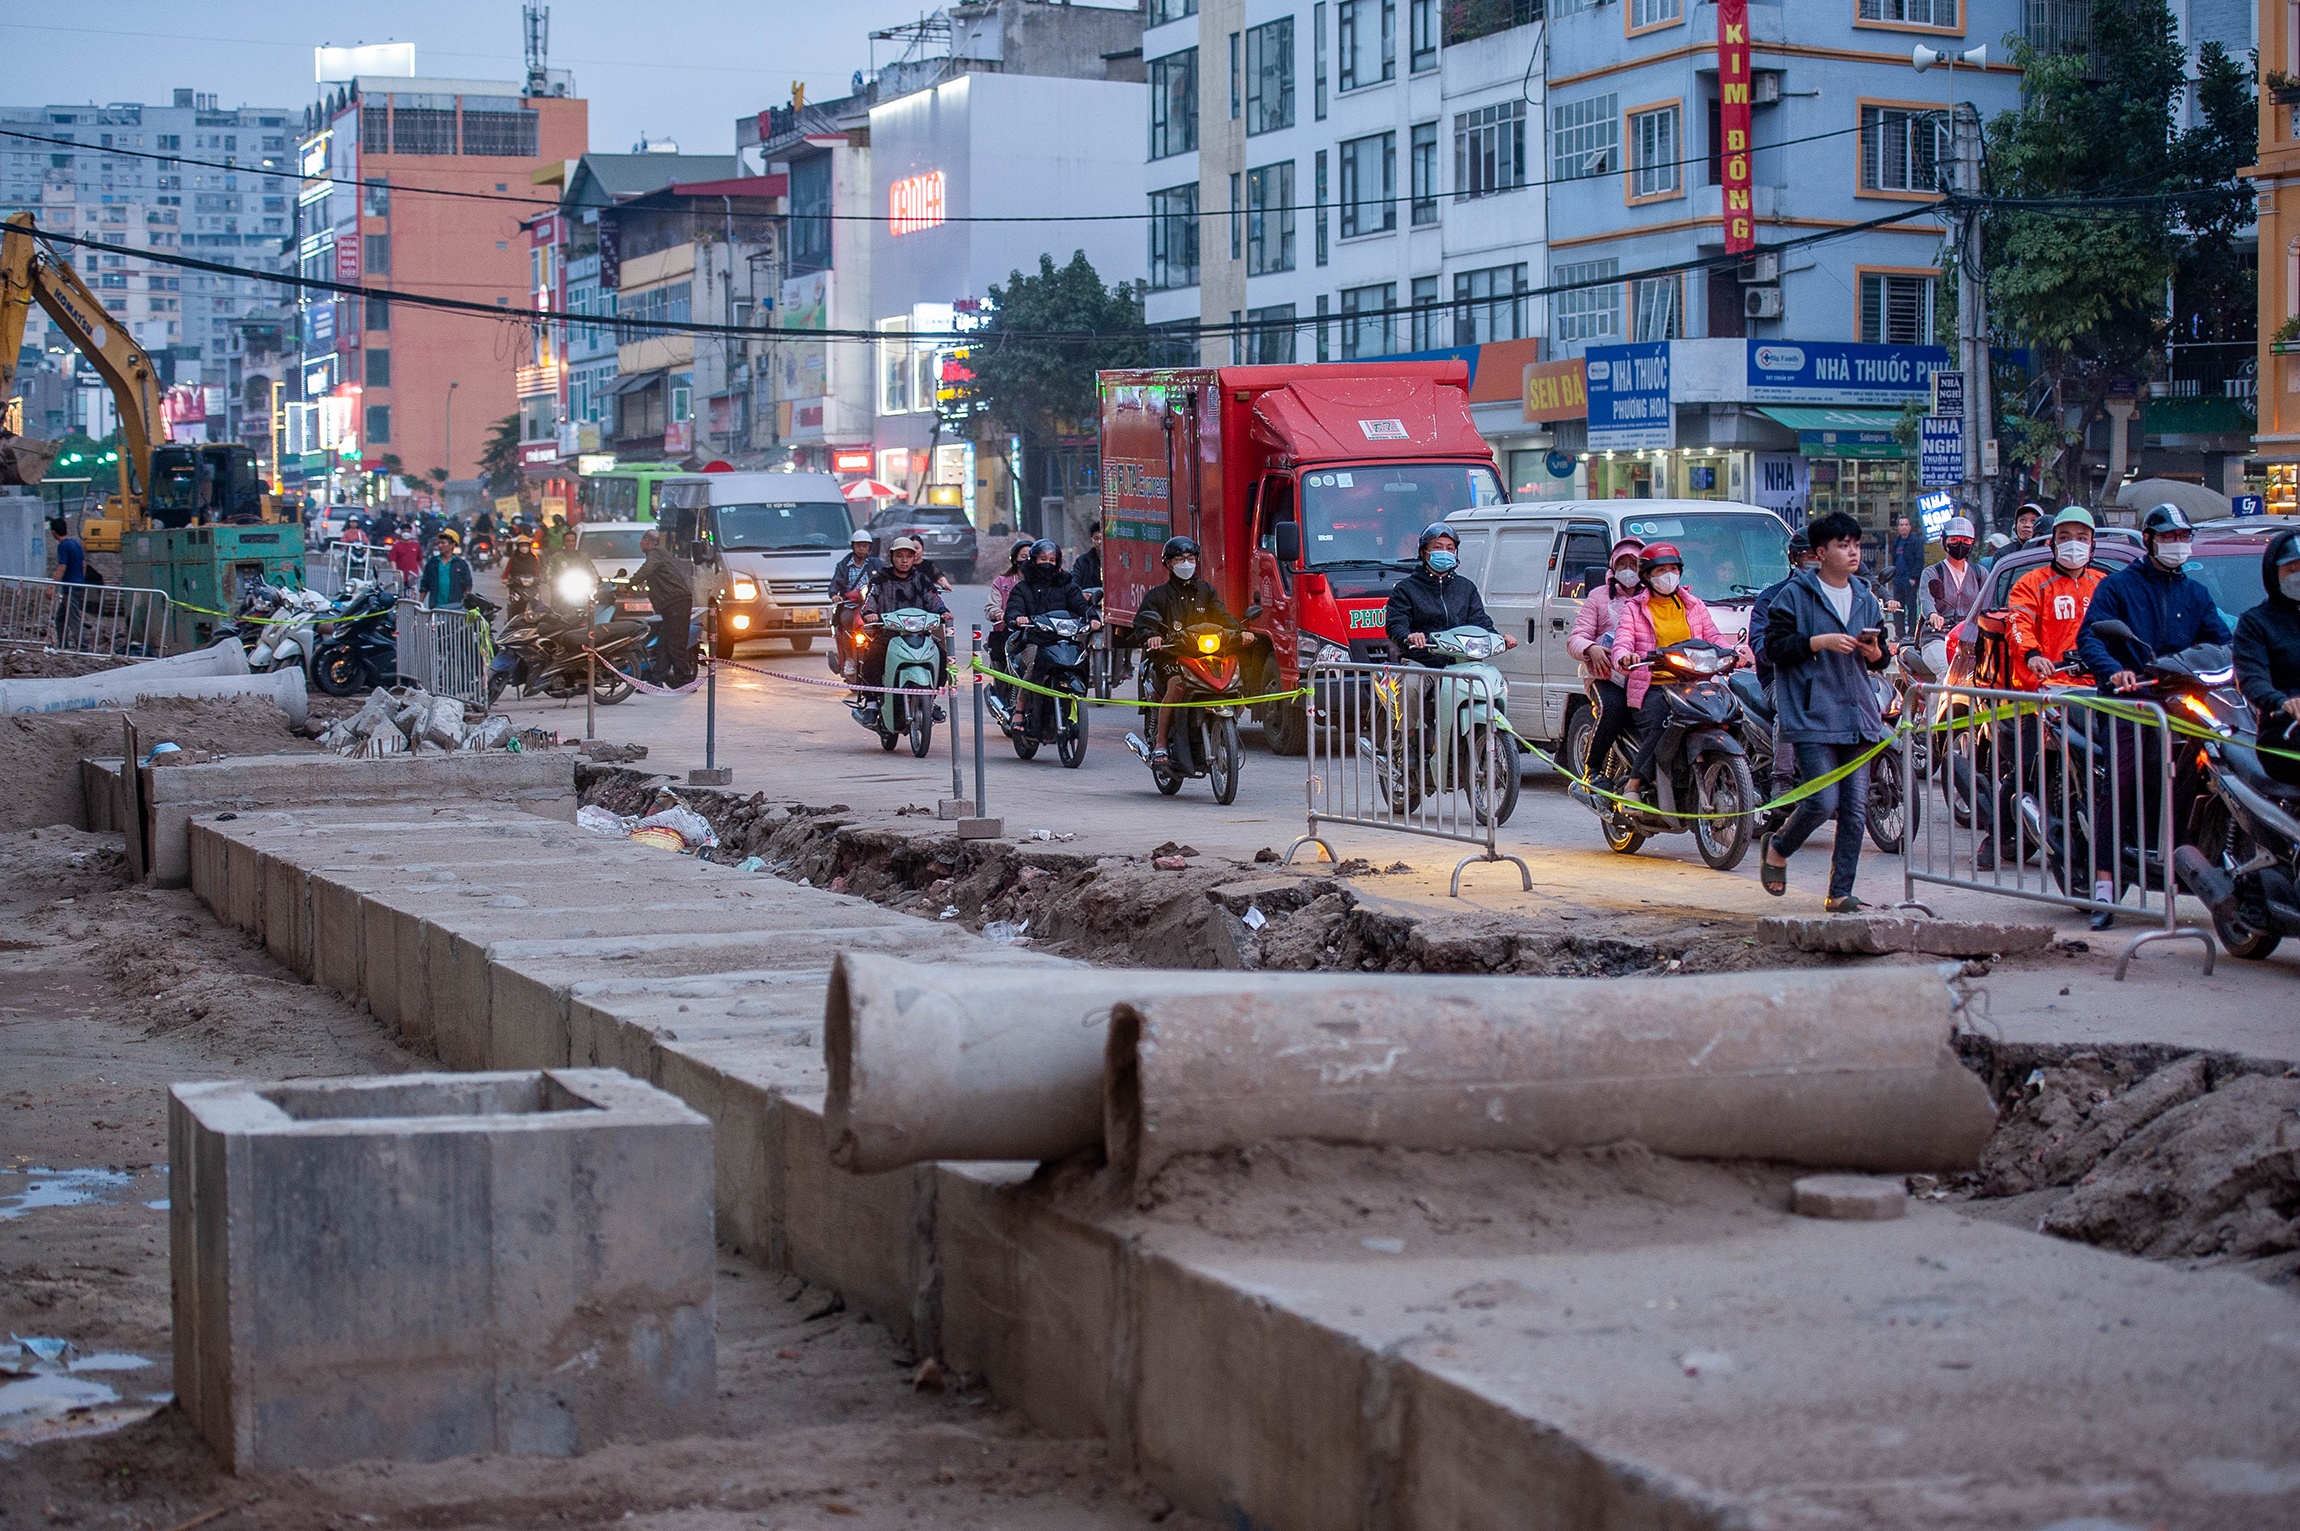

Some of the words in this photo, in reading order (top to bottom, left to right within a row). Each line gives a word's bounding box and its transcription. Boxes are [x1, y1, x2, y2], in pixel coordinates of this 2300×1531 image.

[1724, 24, 1748, 105] KIM
[889, 170, 946, 236] CANIFA
[53, 288, 93, 336] KOMATSU
[1612, 351, 1633, 392] NHÀ
[1634, 344, 1667, 391] THUỐC
[1815, 353, 1850, 381] NHÀ
[1855, 352, 1911, 383] THUỐC
[1530, 376, 1560, 411] SEN
[1561, 366, 1586, 407] ĐÁ
[1939, 387, 1962, 399] NGHỈ
[1940, 377, 1960, 387] NHÀ
[1612, 396, 1647, 420] PHƯƠNG
[1649, 397, 1667, 418] HOA
[1859, 432, 1886, 443] Salonpas
[1925, 417, 1960, 434] NHÀ
[1923, 433, 1962, 454] NGHỈ
[1551, 461, 1568, 469] VIB
[1764, 456, 1795, 491] NHÀ
[1117, 463, 1138, 497] FUTA
[1138, 464, 1168, 504] Express
[2241, 497, 2257, 515] G7
